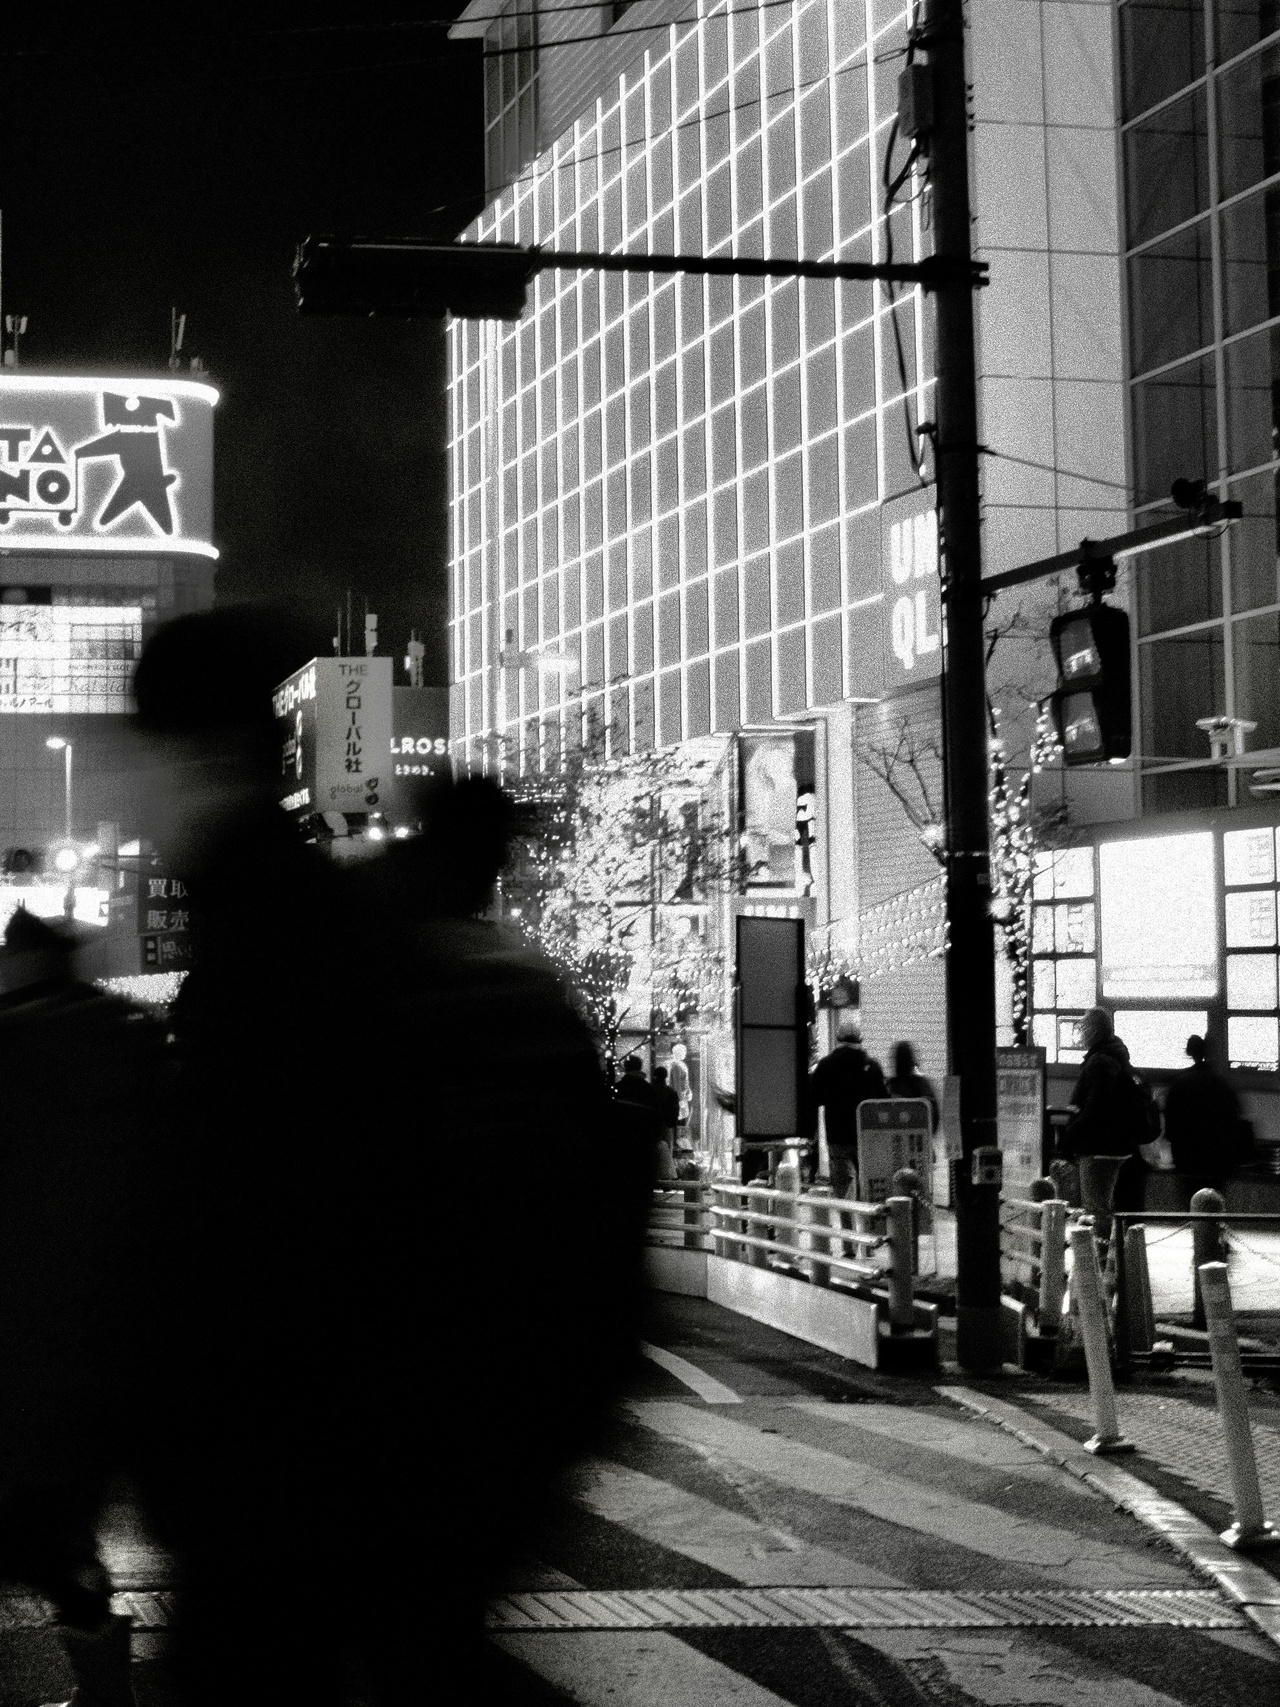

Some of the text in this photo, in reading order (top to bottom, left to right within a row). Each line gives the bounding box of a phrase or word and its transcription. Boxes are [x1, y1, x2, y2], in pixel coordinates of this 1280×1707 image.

[890, 509, 946, 585] UN
[892, 590, 948, 670] QL
[339, 664, 368, 676] THE
[345, 680, 363, 774] グローバル社
[330, 779, 363, 800] global
[147, 878, 189, 899] 買取
[147, 909, 191, 931] 販売
